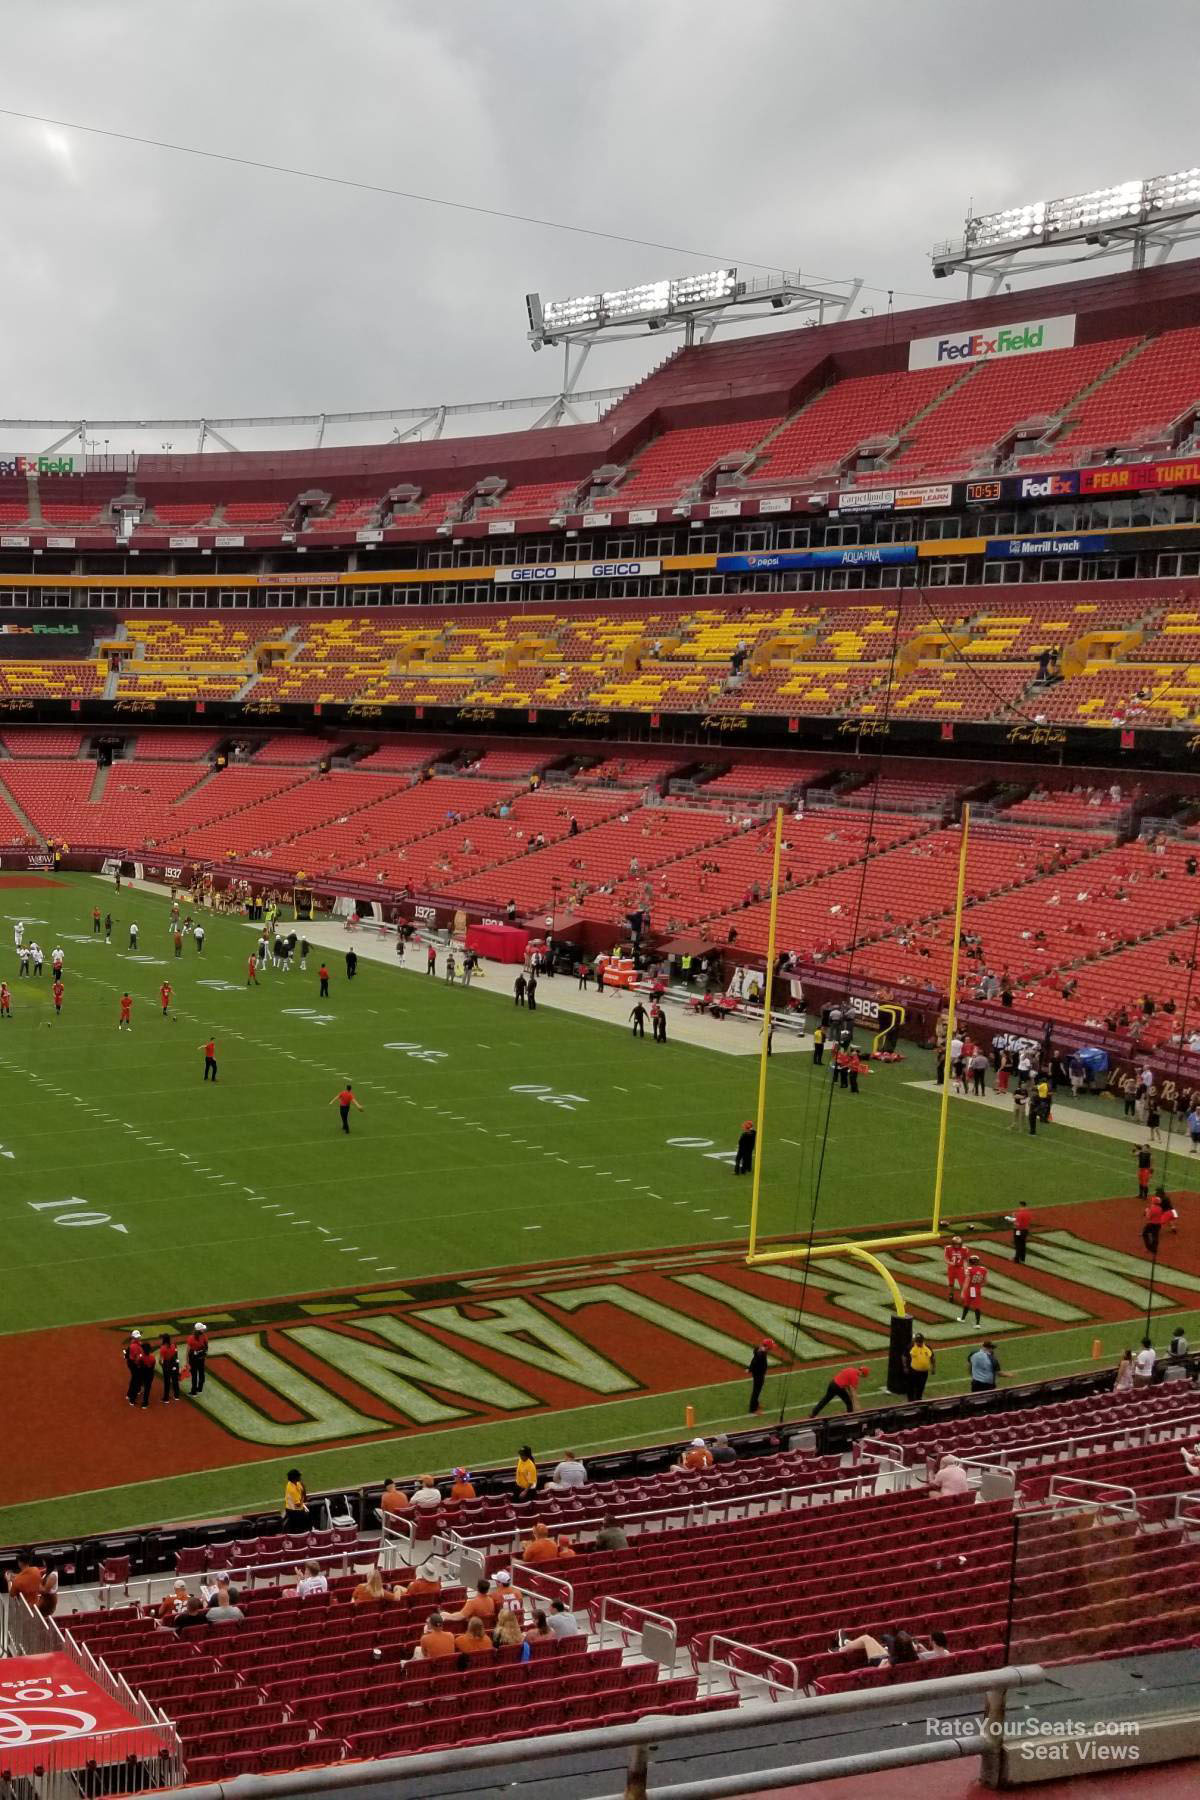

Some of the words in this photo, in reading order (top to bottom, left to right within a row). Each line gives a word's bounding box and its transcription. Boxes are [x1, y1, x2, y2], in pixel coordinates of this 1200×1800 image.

[937, 325, 1044, 362] FedExField
[1021, 475, 1072, 498] FedEx
[1021, 541, 1051, 553] Merrill
[1053, 540, 1080, 553] Lynch
[757, 557, 780, 567] pepsi
[841, 549, 881, 564] AQUAFINA
[511, 567, 557, 581] GEICO
[592, 563, 641, 577] GEICO
[164, 867, 182, 879] 1937
[415, 905, 436, 919] 1972
[850, 997, 880, 1019] 1983
[27, 1196, 113, 1228] 10
[156, 1230, 1200, 1446] MARYLAND
[2, 1676, 52, 1688] Let's
